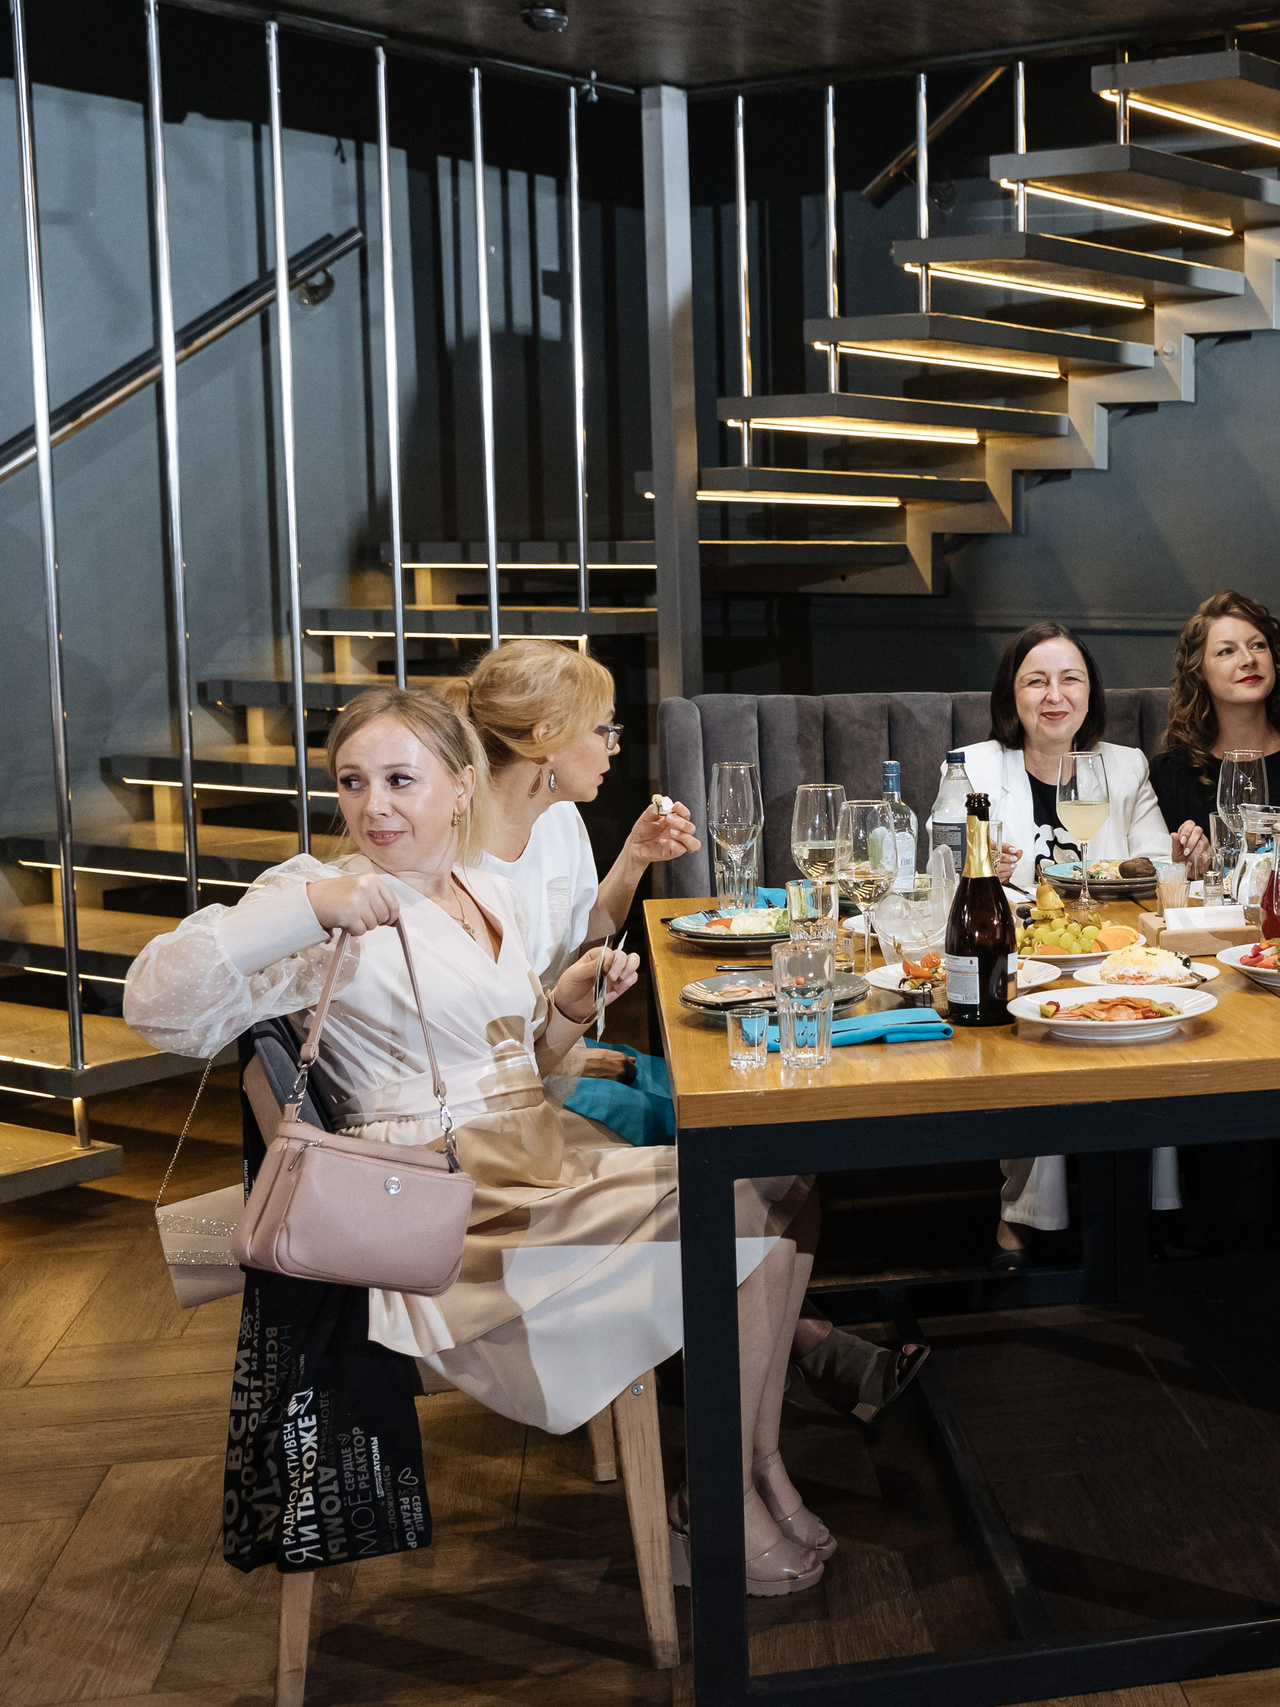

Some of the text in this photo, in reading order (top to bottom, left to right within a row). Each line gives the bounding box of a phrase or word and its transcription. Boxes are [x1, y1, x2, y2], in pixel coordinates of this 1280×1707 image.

[250, 1352, 258, 1371] ИЗ
[226, 1348, 251, 1471] ВСЕМ
[241, 1376, 263, 1503] СОСТОИТ
[319, 1390, 330, 1462] ЗДОРОВЫЕ
[296, 1414, 320, 1543] И ТЫ ТОЖЕ
[352, 1426, 371, 1490] РЕАКТОР
[370, 1436, 381, 1471] АТОМЫ
[282, 1421, 323, 1563] Я РАДИОАКТИВЕН
[317, 1465, 348, 1560] АТОМЫ
[342, 1446, 379, 1555] МОЁ СЕРДЦЕ
[383, 1464, 398, 1531] СЛОЖИЛИСЬ
[399, 1497, 418, 1549] РЕАКТОР
[411, 1495, 425, 1532] СЕРДЦЕ
